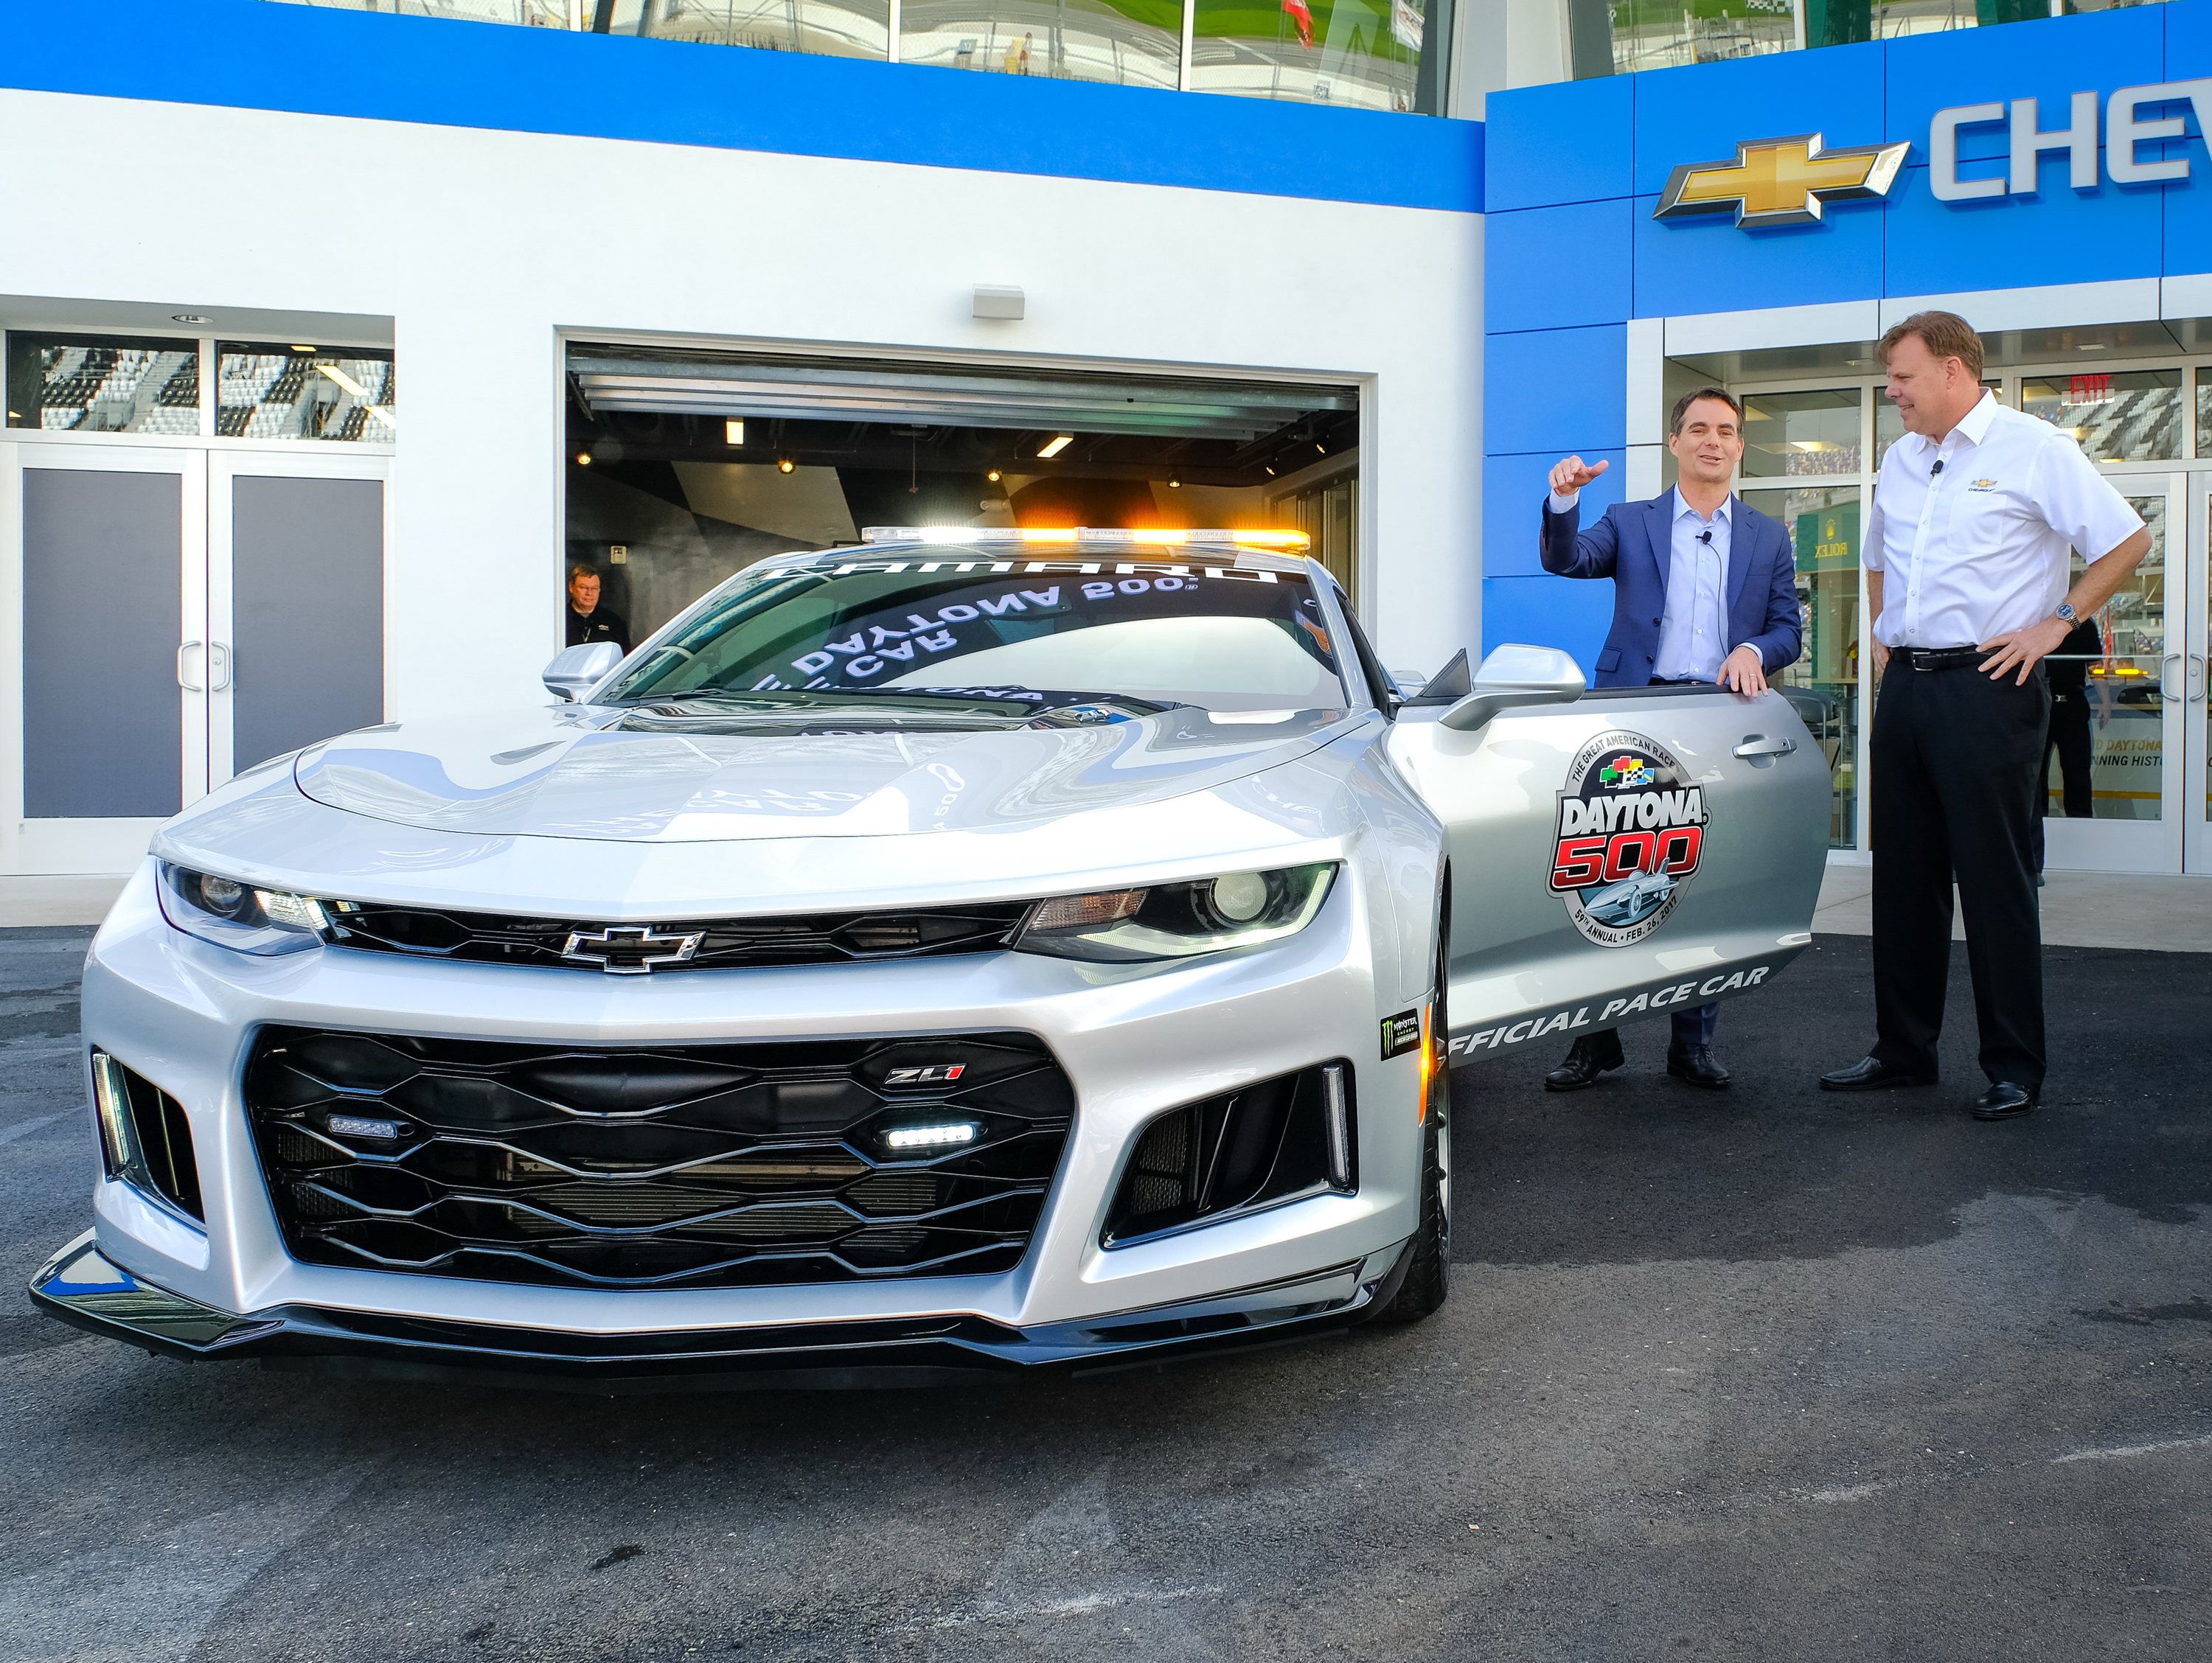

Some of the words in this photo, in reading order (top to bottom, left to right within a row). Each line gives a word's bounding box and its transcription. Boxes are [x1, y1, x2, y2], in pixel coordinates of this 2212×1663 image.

[2070, 375, 2110, 403] EXIT
[762, 562, 1279, 583] CAMARO
[1572, 761, 1585, 783] THE
[1583, 739, 1606, 764] GREAT
[1606, 735, 1650, 752] AMERICAN
[1652, 745, 1675, 769] RACE
[2132, 755, 2163, 767] HIST
[1561, 789, 1703, 836] DAYTONA
[1552, 826, 1703, 888] 500
[1574, 909, 1590, 926] 59TH
[1586, 924, 1618, 943] ANNUAL
[1626, 927, 1645, 941] FEB.
[1646, 918, 1660, 932] 26,
[1660, 895, 1677, 921] 2017
[1394, 1017, 1418, 1031] MONSTER
[1448, 1007, 1590, 1056] FFICIAL
[1599, 981, 1698, 1022] PACE
[1698, 966, 1770, 997] CAR
[885, 1065, 965, 1084] ZL1
